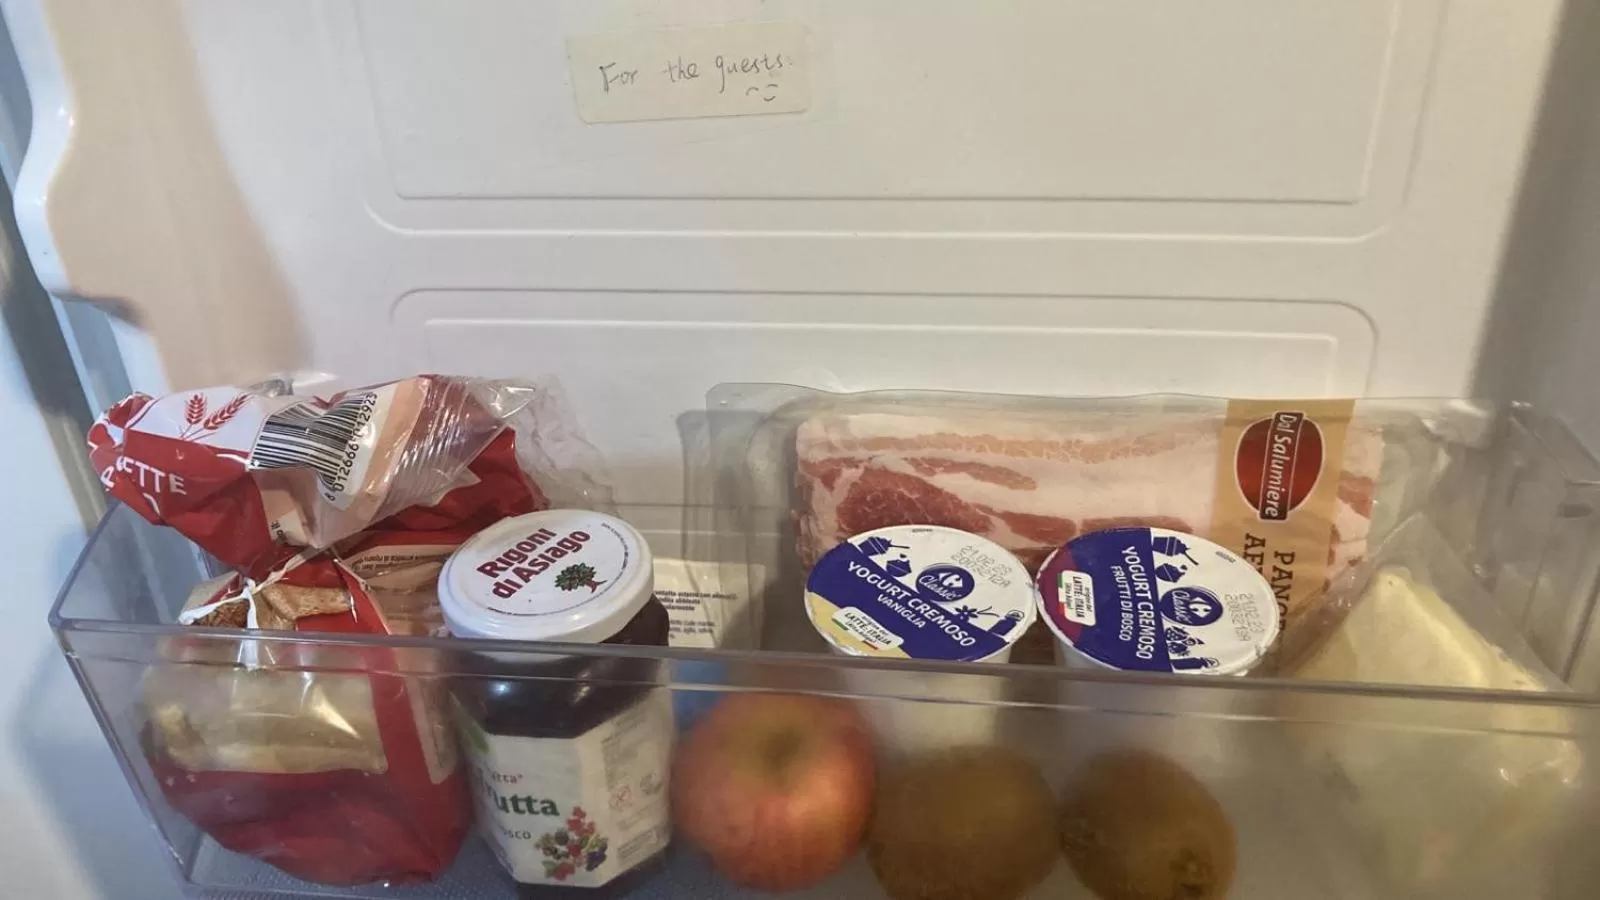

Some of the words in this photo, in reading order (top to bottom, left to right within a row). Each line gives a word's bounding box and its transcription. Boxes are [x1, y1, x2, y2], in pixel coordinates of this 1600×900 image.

[599, 62, 639, 95] For
[662, 56, 700, 83] the
[1265, 434, 1291, 517] Salumiere
[476, 527, 558, 580] Rigoni
[492, 575, 524, 599] di
[515, 529, 592, 584] Asiago
[1121, 546, 1153, 600] YOGURT
[1243, 533, 1265, 574] AF
[847, 561, 910, 600] YOGURT
[907, 596, 976, 647] CREMOSO
[1110, 565, 1131, 596] FRUTTI
[877, 593, 926, 628] VANIGLIA
[1118, 606, 1134, 641] BOSCO
[1135, 598, 1156, 660] CREMOSO
